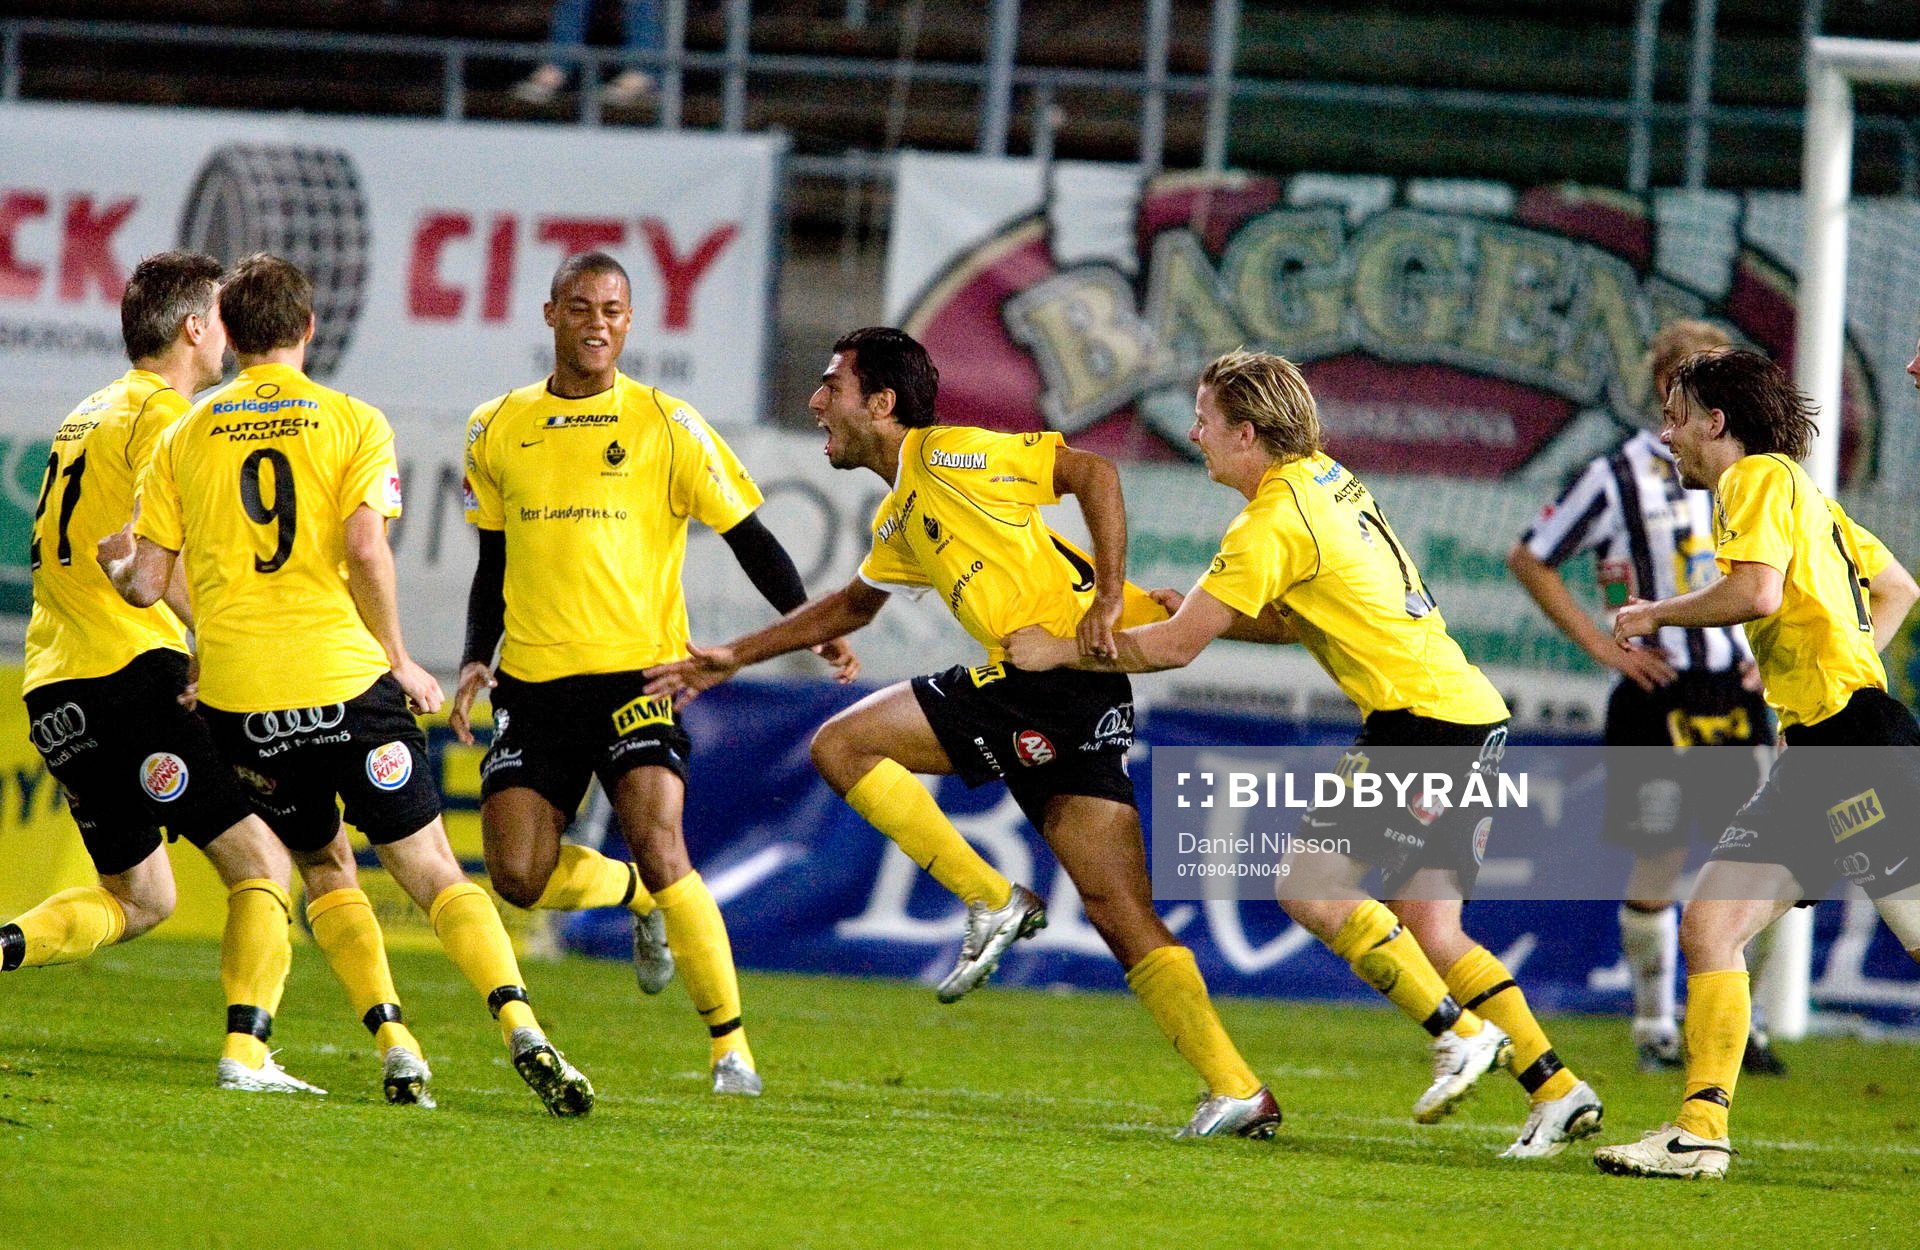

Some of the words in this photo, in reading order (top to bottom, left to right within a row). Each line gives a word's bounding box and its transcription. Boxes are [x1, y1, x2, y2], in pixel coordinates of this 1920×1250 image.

[212, 398, 318, 415] Rörläggaren
[565, 414, 618, 424] K-RAUTA
[210, 418, 319, 436] AUTOTECH
[229, 427, 299, 442] MALMÖ
[929, 449, 987, 469] STADIUM
[31, 448, 87, 572] 21
[240, 448, 297, 573] 9
[618, 699, 670, 729] BMK
[258, 741, 292, 758] Audi
[372, 745, 402, 772] BURGER
[152, 761, 179, 795] KING
[376, 753, 406, 782] KING
[1829, 796, 1880, 836] BMK
